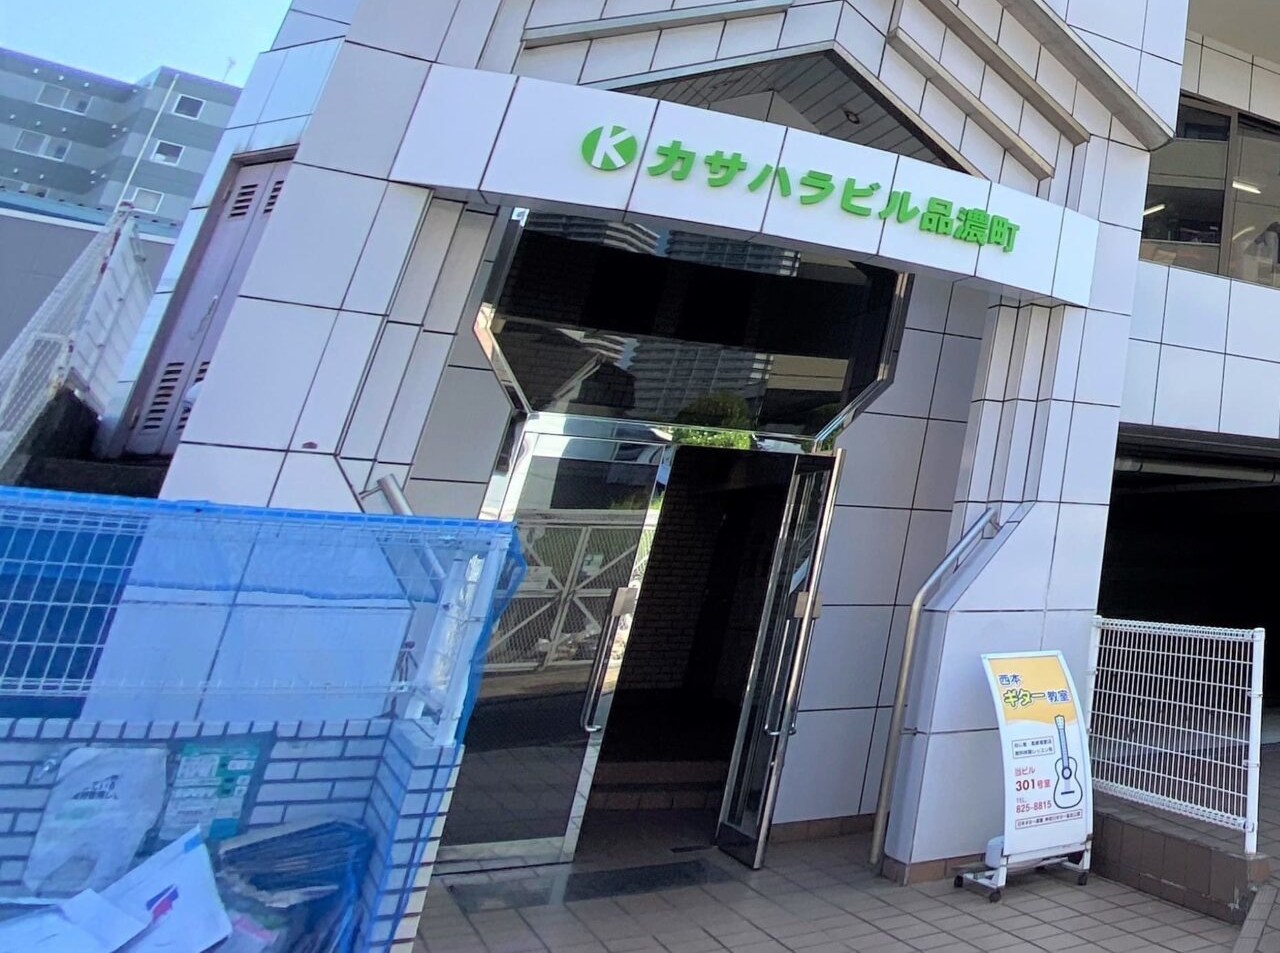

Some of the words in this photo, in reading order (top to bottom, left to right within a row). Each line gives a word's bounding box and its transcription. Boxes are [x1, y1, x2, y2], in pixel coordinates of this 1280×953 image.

[647, 140, 1019, 252] カサハラビル品濃町
[999, 674, 1020, 686] 西本
[1003, 688, 1070, 707] ギター教室
[1014, 766, 1036, 777] 当ビル
[1015, 778, 1051, 792] 301号室
